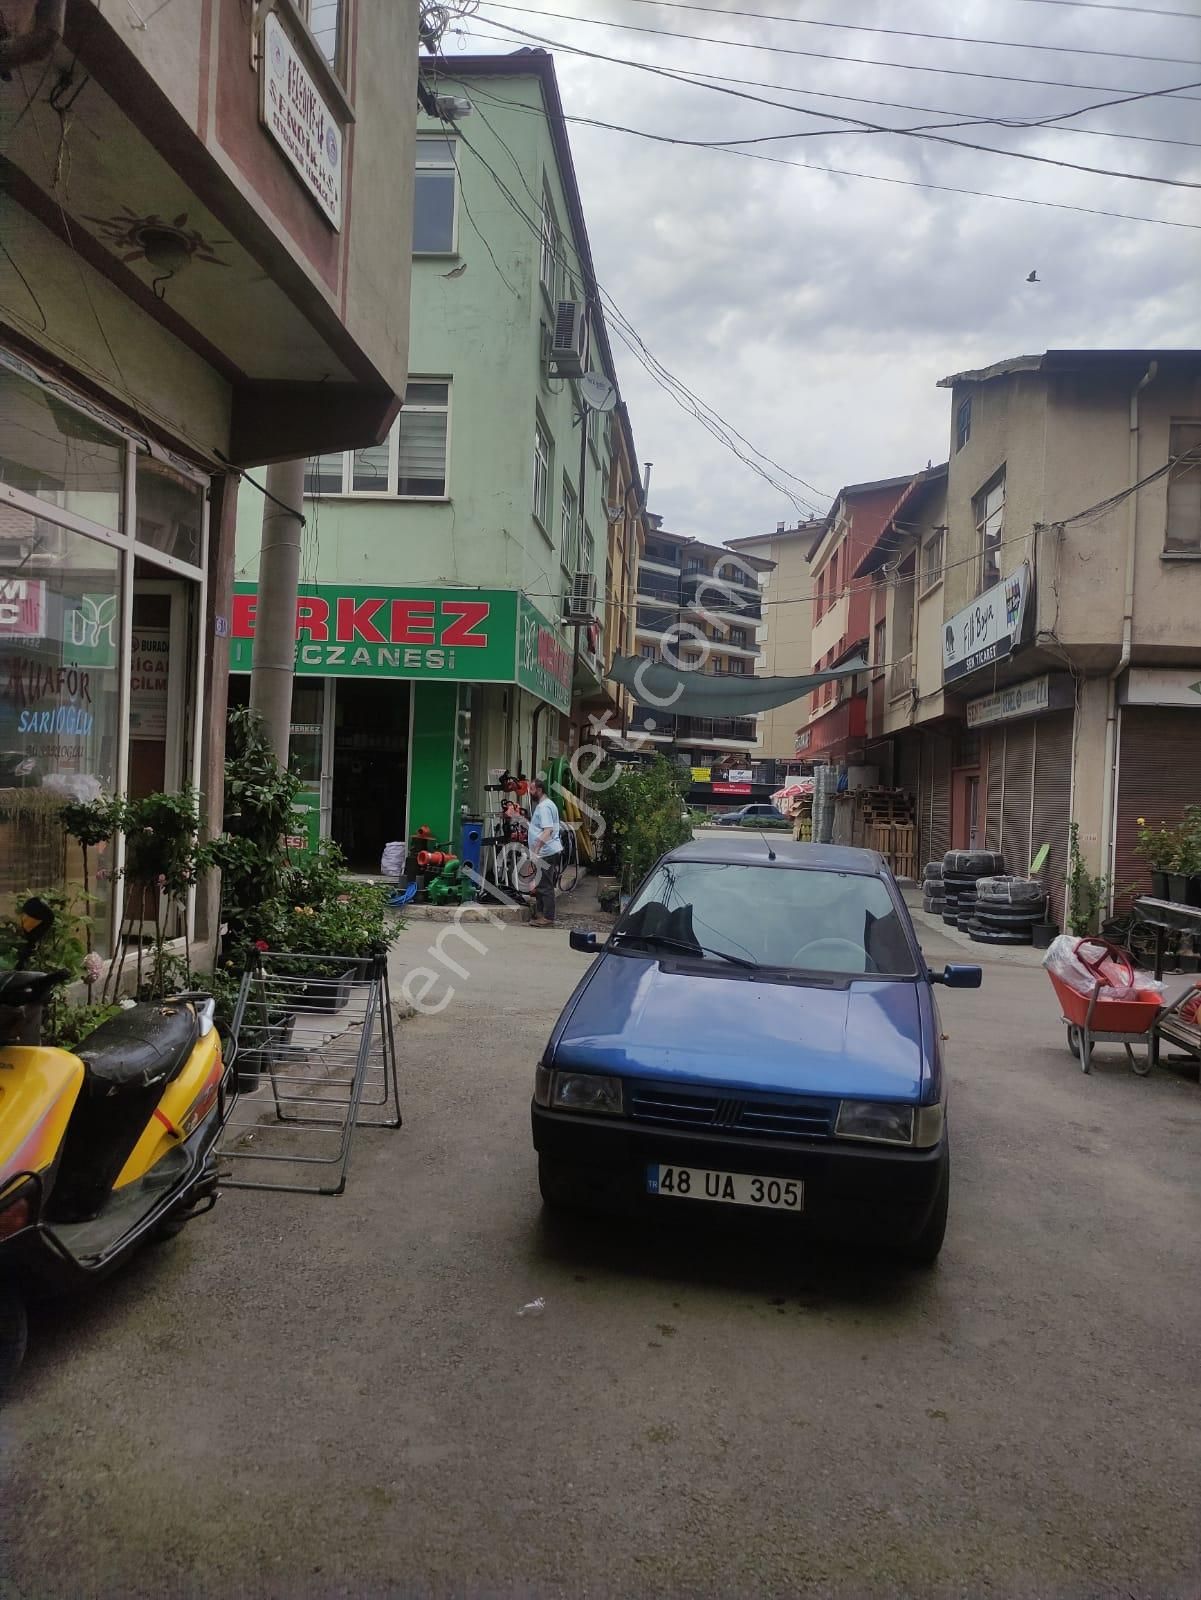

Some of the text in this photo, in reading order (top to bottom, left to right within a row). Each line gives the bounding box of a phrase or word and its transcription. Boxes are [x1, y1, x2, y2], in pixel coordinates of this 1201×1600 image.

[131, 658, 169, 672] İGA
[648, 1180, 658, 1188] TR
[660, 1168, 799, 1206] 48 UA 305
